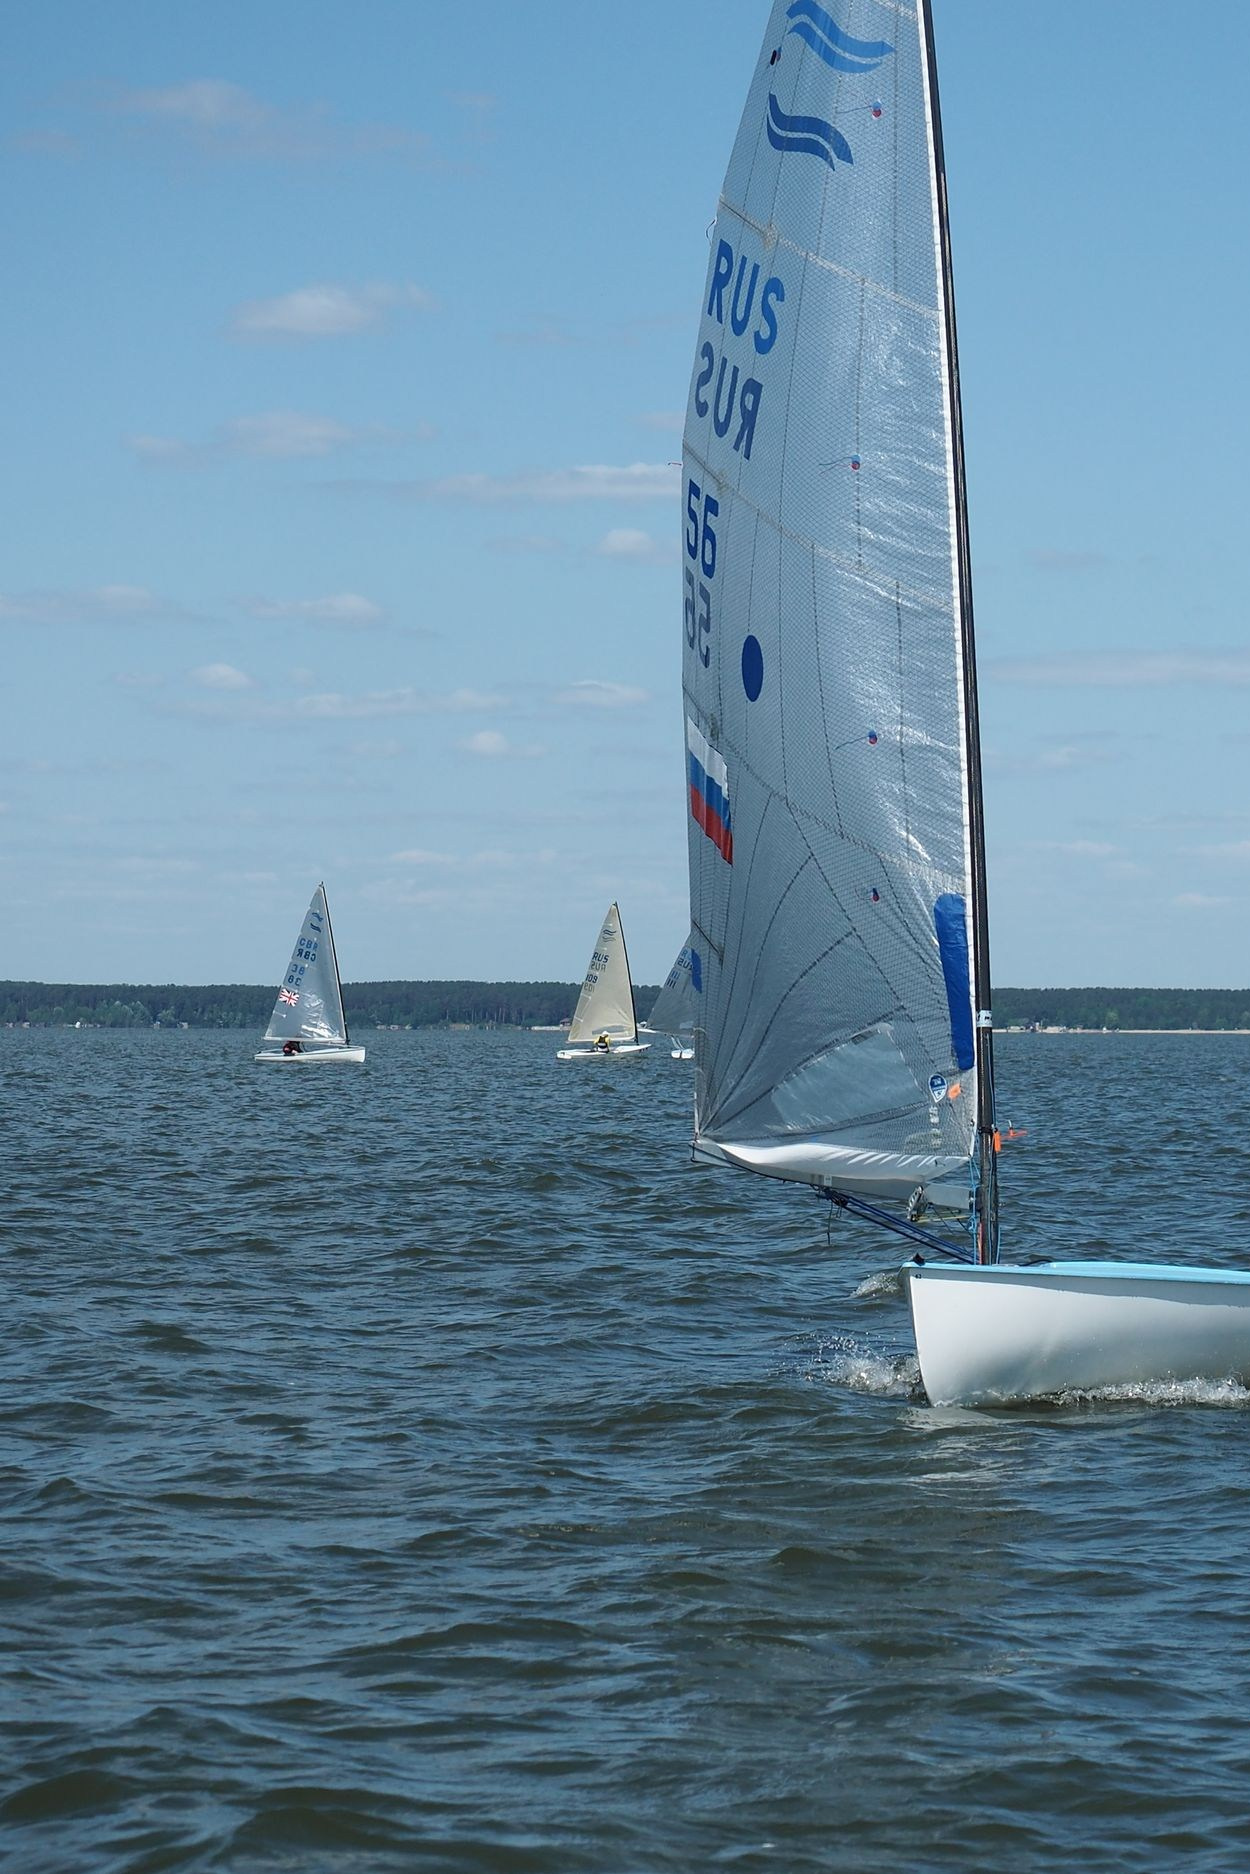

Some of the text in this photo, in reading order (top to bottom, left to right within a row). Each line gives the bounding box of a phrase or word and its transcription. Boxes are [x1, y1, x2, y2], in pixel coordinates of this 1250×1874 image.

[707, 238, 785, 355] RUS
[686, 477, 719, 580] 56
[585, 974, 599, 984] 109
[592, 951, 610, 964] RUS
